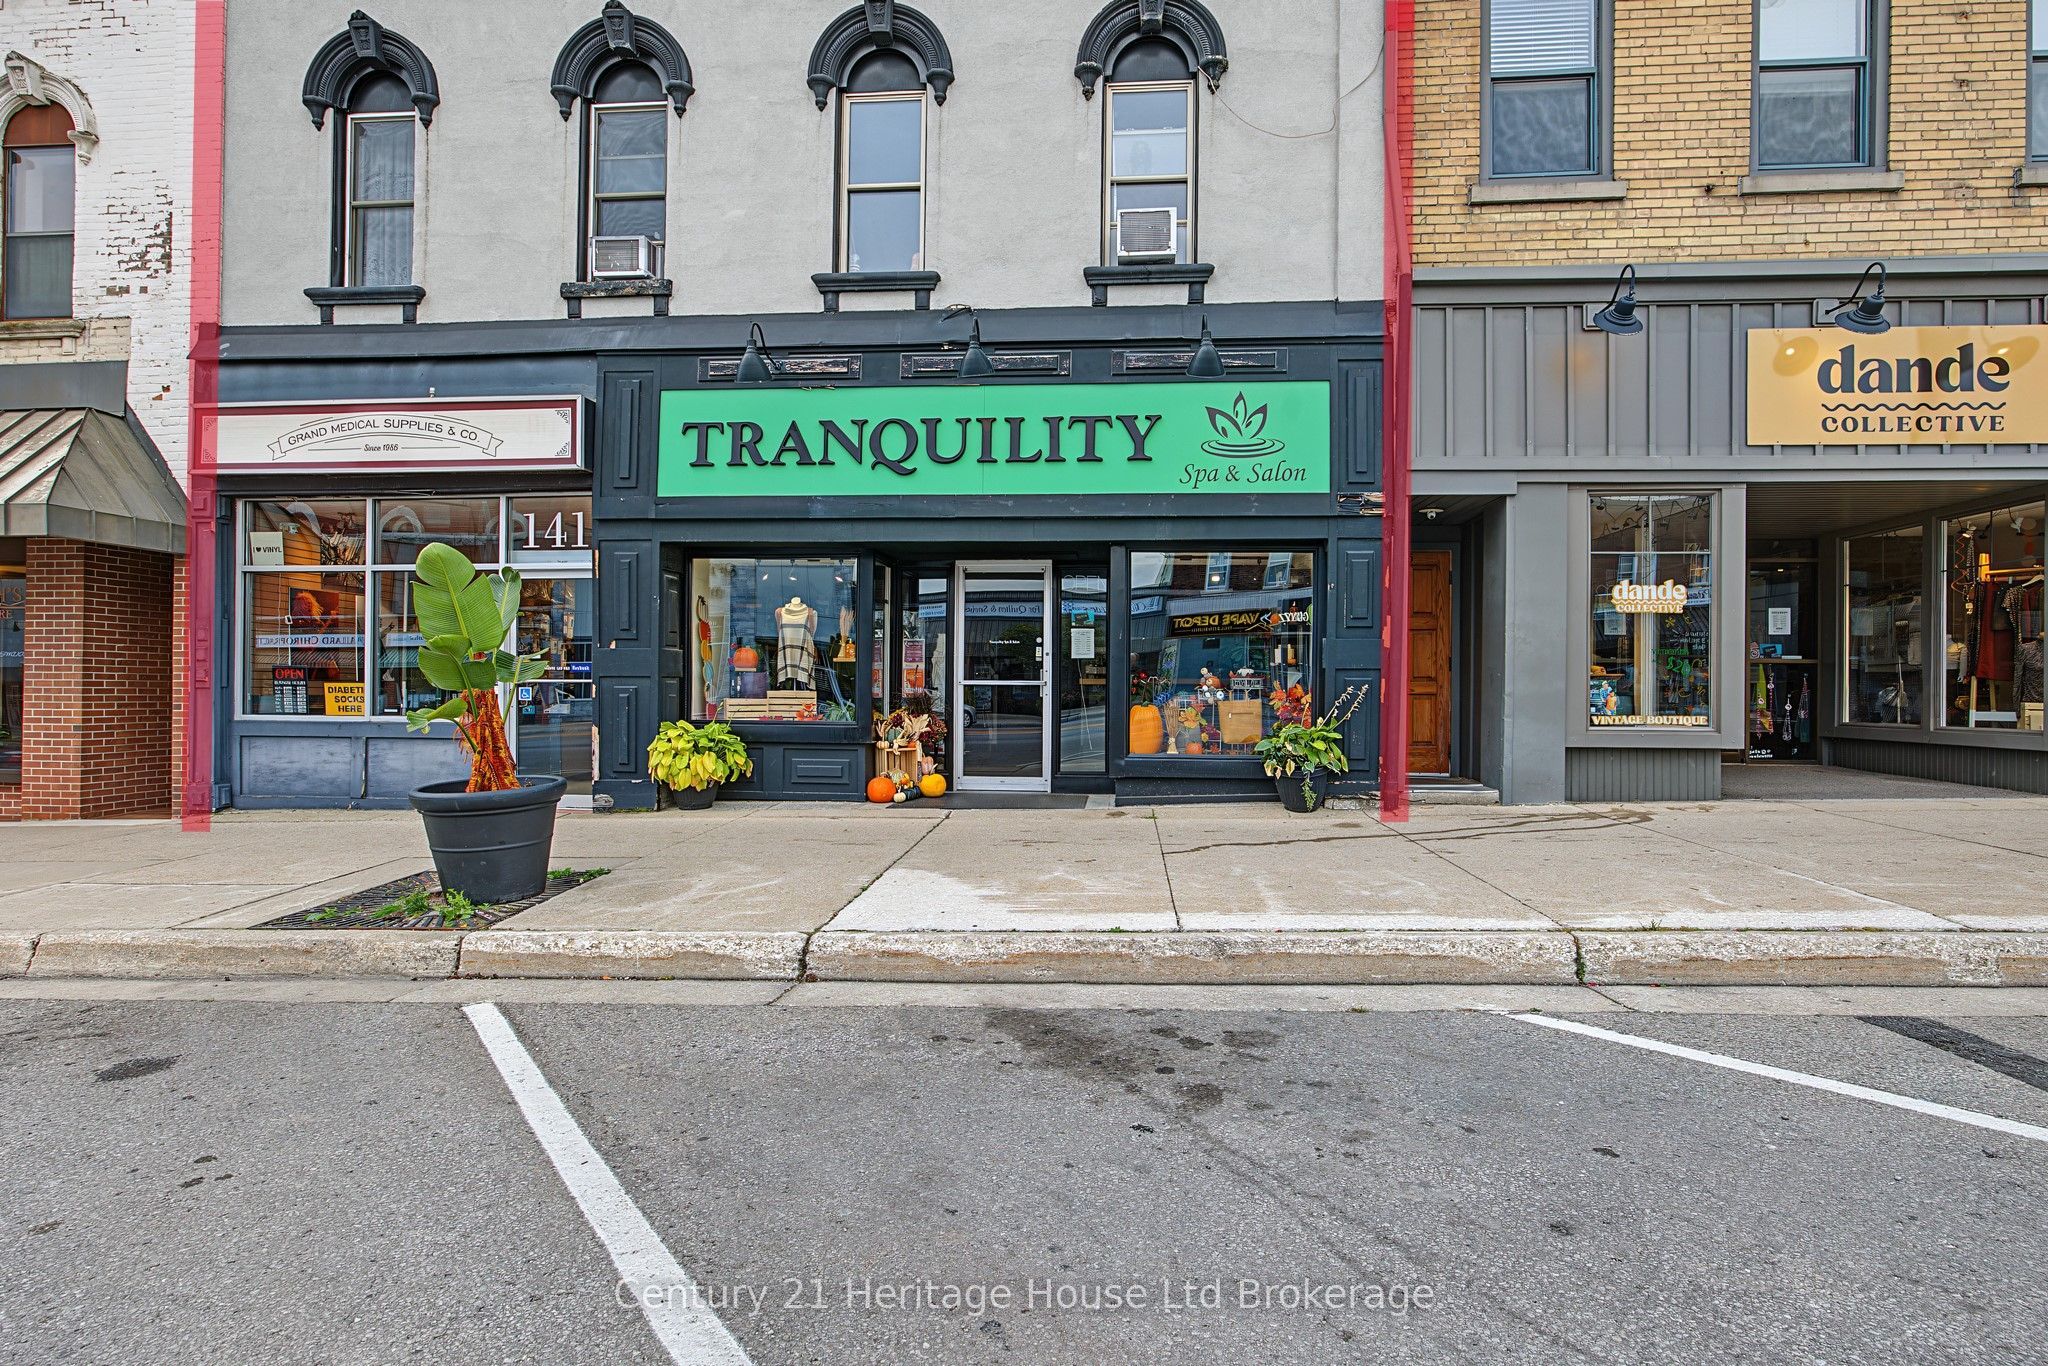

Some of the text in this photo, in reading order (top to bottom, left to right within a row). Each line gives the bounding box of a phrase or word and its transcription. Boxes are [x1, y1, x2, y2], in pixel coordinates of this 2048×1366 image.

[1817, 342, 2011, 394] dande
[288, 418, 480, 446] GRAND MEDICAL SUPPLIES & CO.
[1821, 415, 2005, 433] COLLECTIVE
[364, 443, 381, 452] Since
[681, 413, 1162, 477] TRANQUILITY
[1179, 460, 1307, 490] Spa & Salon
[522, 511, 589, 548] 141
[1612, 579, 1688, 601] dande
[1616, 604, 1684, 613] COLLECTIVE
[275, 668, 305, 680] OPEN
[337, 705, 363, 713] HERE
[1591, 715, 1709, 727] VINTAGE BOUTIQUE
